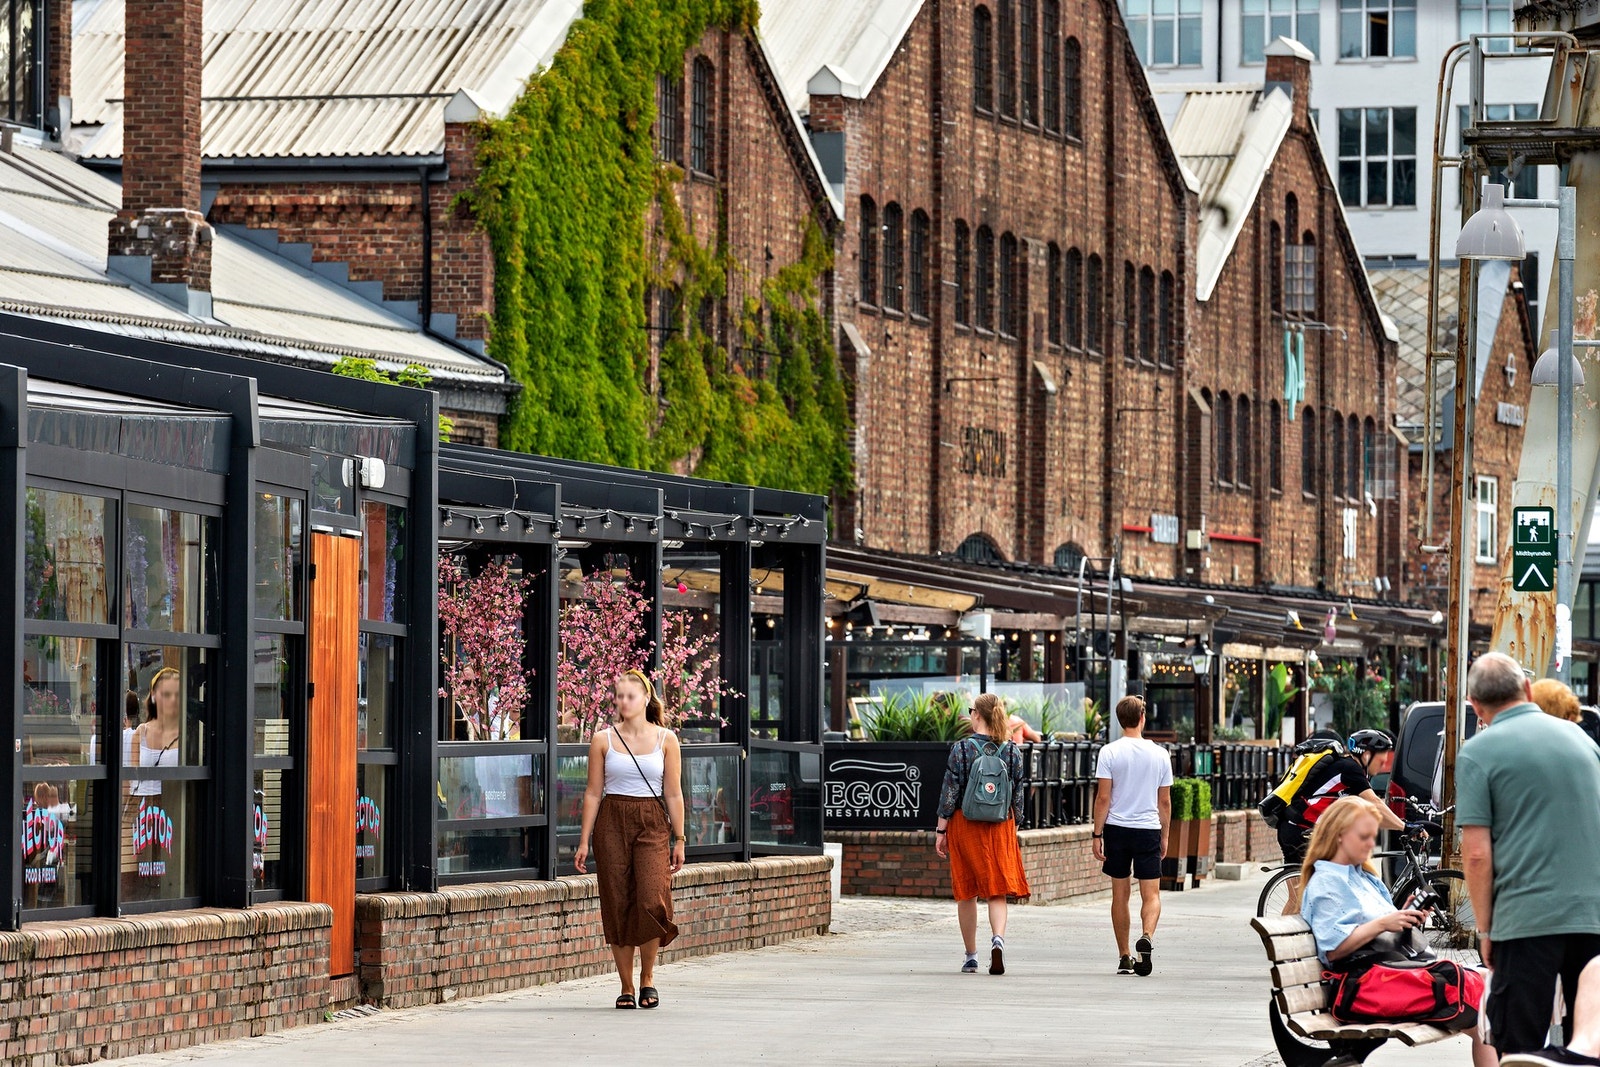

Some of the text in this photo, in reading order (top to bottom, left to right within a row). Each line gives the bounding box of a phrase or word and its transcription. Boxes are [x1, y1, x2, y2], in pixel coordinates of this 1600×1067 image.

[824, 781, 921, 809] EGON
[826, 809, 919, 817] RESTAURANT
[25, 867, 37, 884] FOOD
